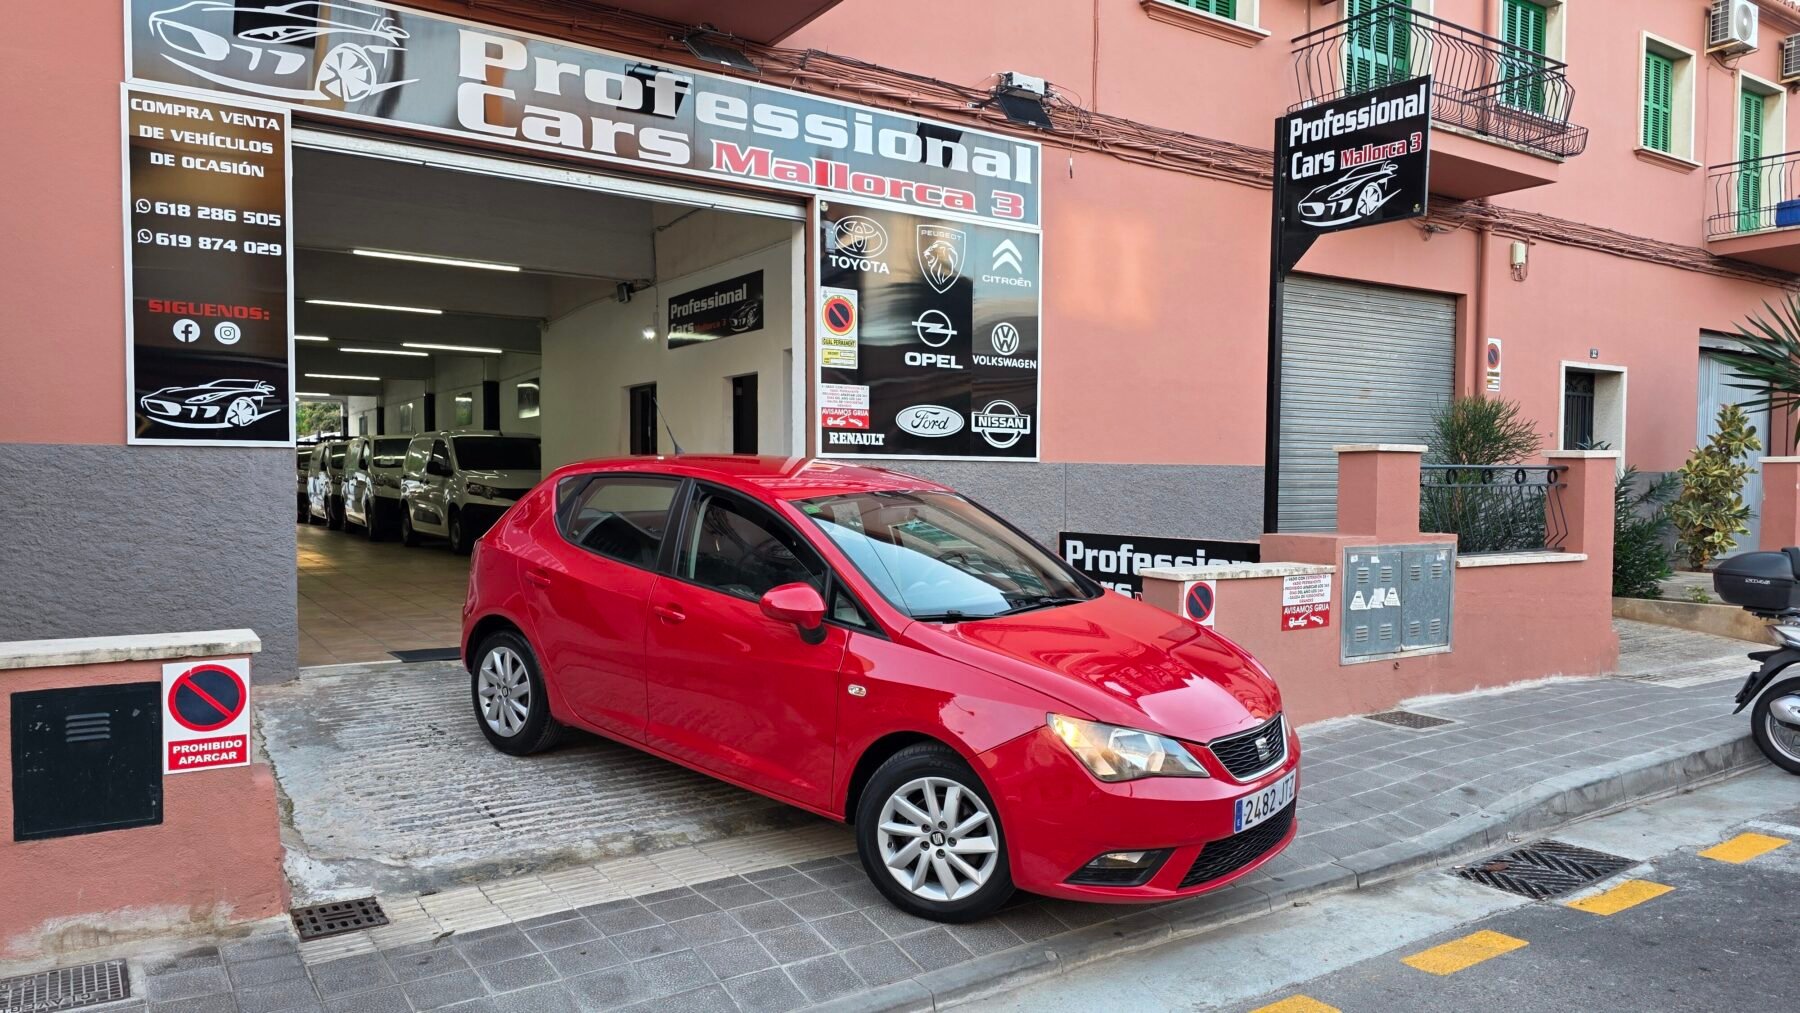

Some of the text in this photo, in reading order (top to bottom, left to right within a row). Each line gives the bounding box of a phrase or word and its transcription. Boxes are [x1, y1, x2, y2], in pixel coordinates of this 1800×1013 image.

[130, 98, 280, 131] COMPRA VENTA
[458, 29, 1032, 184] Professional
[1289, 84, 1427, 147] Professional
[139, 124, 274, 154] DE VEHÍCULOS
[457, 82, 1025, 220] Cars Mallorca 3
[1291, 131, 1423, 181] Cars Mallorca 3
[150, 151, 265, 178] DE OCASIÓN
[154, 201, 282, 227] 618 286 505
[155, 232, 283, 256] 619 874 029
[920, 229, 962, 241] PEUGEOT
[829, 254, 890, 274] TOYOTA
[147, 298, 271, 320] SIGUENOS:
[670, 283, 747, 320] Professional
[904, 351, 964, 369] OPEL
[972, 354, 1037, 370] VOLKSWAGEN
[822, 408, 852, 417] AVISAMOS
[910, 409, 950, 430] Ford
[978, 416, 1025, 429] NISSAN
[829, 431, 885, 446] RENAULT
[1283, 604, 1313, 615] AVISAMOS
[172, 739, 243, 754] PROHIBIDO
[178, 751, 238, 765] APARCAR
[1244, 788, 1276, 825] 2482
